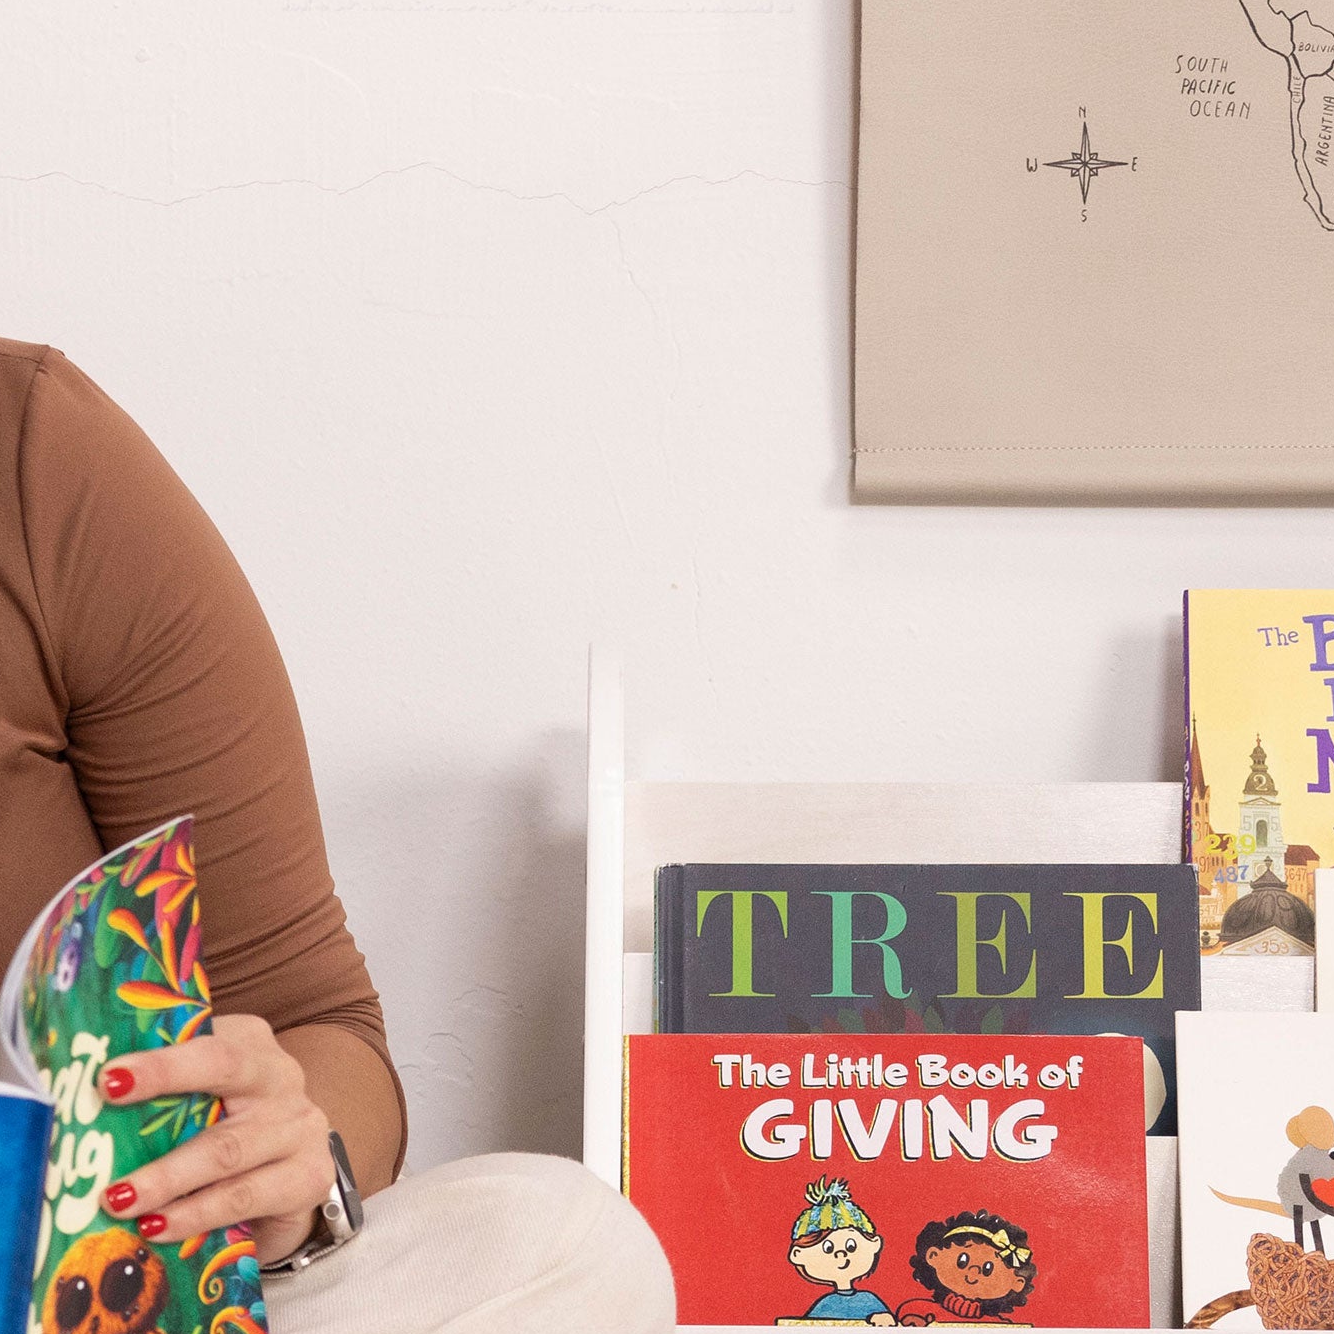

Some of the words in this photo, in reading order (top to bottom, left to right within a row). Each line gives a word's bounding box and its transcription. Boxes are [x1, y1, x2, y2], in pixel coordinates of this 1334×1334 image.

[1175, 54, 1229, 74] SOUTH
[1180, 78, 1236, 95] PACIFIC
[1292, 75, 1302, 104] CHILE
[1078, 106, 1087, 118] N
[1189, 100, 1251, 119] OCEAN
[1027, 157, 1038, 173] W
[1131, 157, 1138, 171] E
[1080, 209, 1088, 222] S
[1257, 625, 1299, 647] The
[1204, 834, 1257, 860] 239
[696, 890, 1165, 1000] TREE
[712, 1053, 791, 1089] The
[801, 1053, 906, 1090] Little
[917, 1053, 1029, 1090] Book
[1039, 1054, 1084, 1090] of
[739, 1098, 1059, 1163] GIVING
